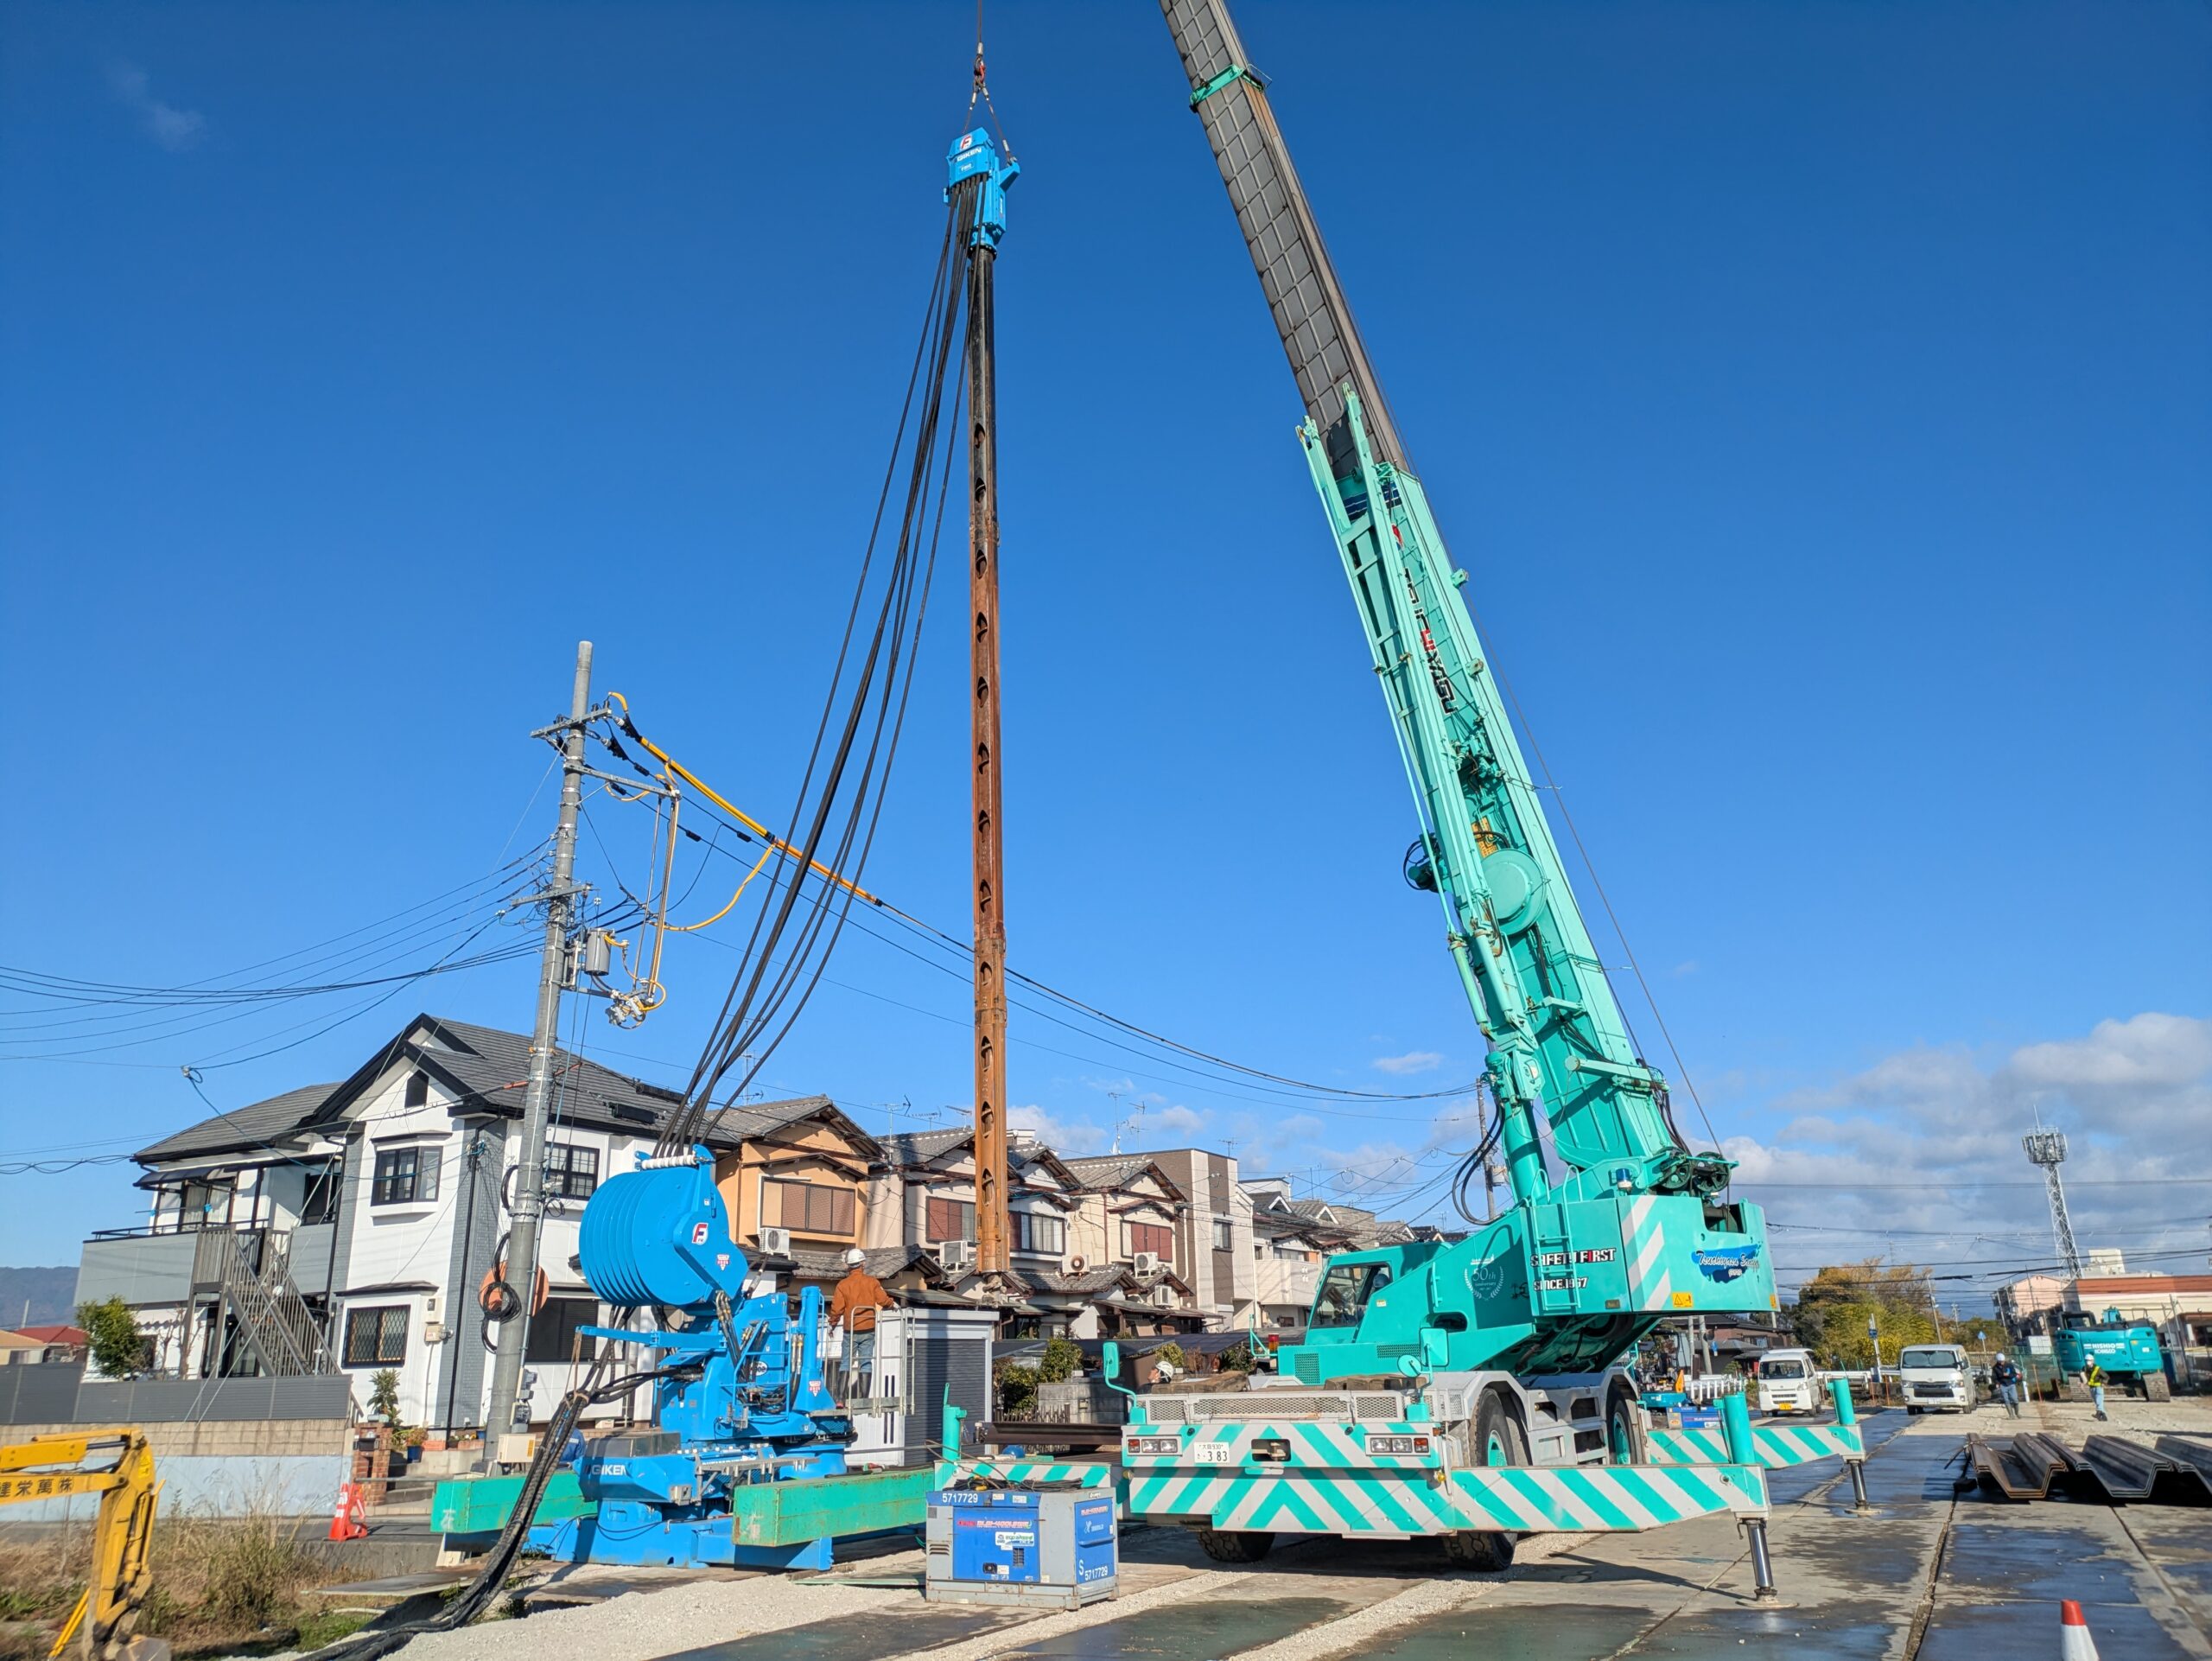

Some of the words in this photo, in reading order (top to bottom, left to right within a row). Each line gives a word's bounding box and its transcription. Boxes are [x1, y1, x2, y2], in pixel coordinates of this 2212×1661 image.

[957, 147, 982, 162] GIKEN
[1579, 1247, 1616, 1263] FIRST
[1473, 1267, 1497, 1281] 50th
[942, 1492, 978, 1504] 5717729
[1078, 1559, 1084, 1575] S
[1084, 1565, 1109, 1581] 5717729
